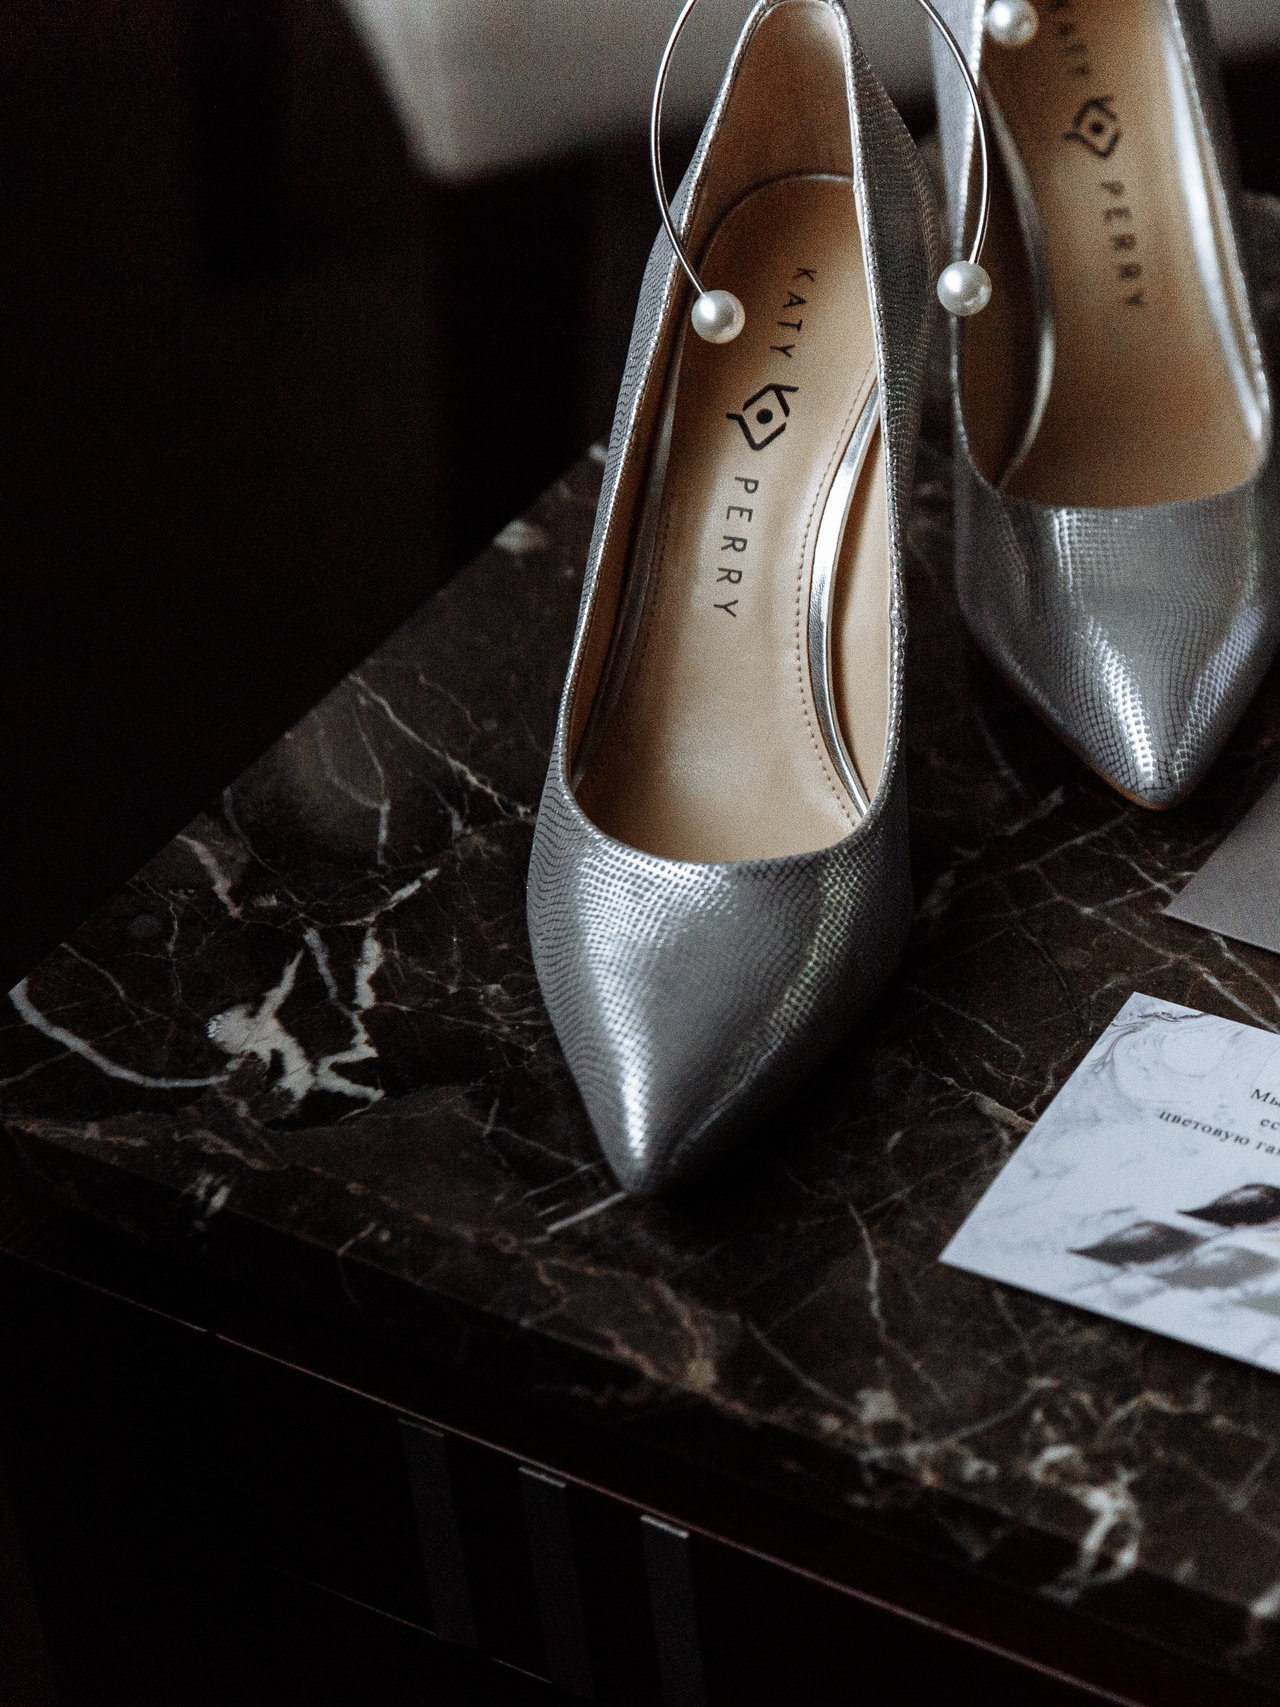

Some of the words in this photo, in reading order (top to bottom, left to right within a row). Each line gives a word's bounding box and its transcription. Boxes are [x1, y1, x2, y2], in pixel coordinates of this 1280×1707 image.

[1101, 179, 1145, 307] PERRY
[769, 267, 817, 358] KATY
[713, 476, 759, 617] PERRY
[1158, 1110, 1250, 1147] цветовую
